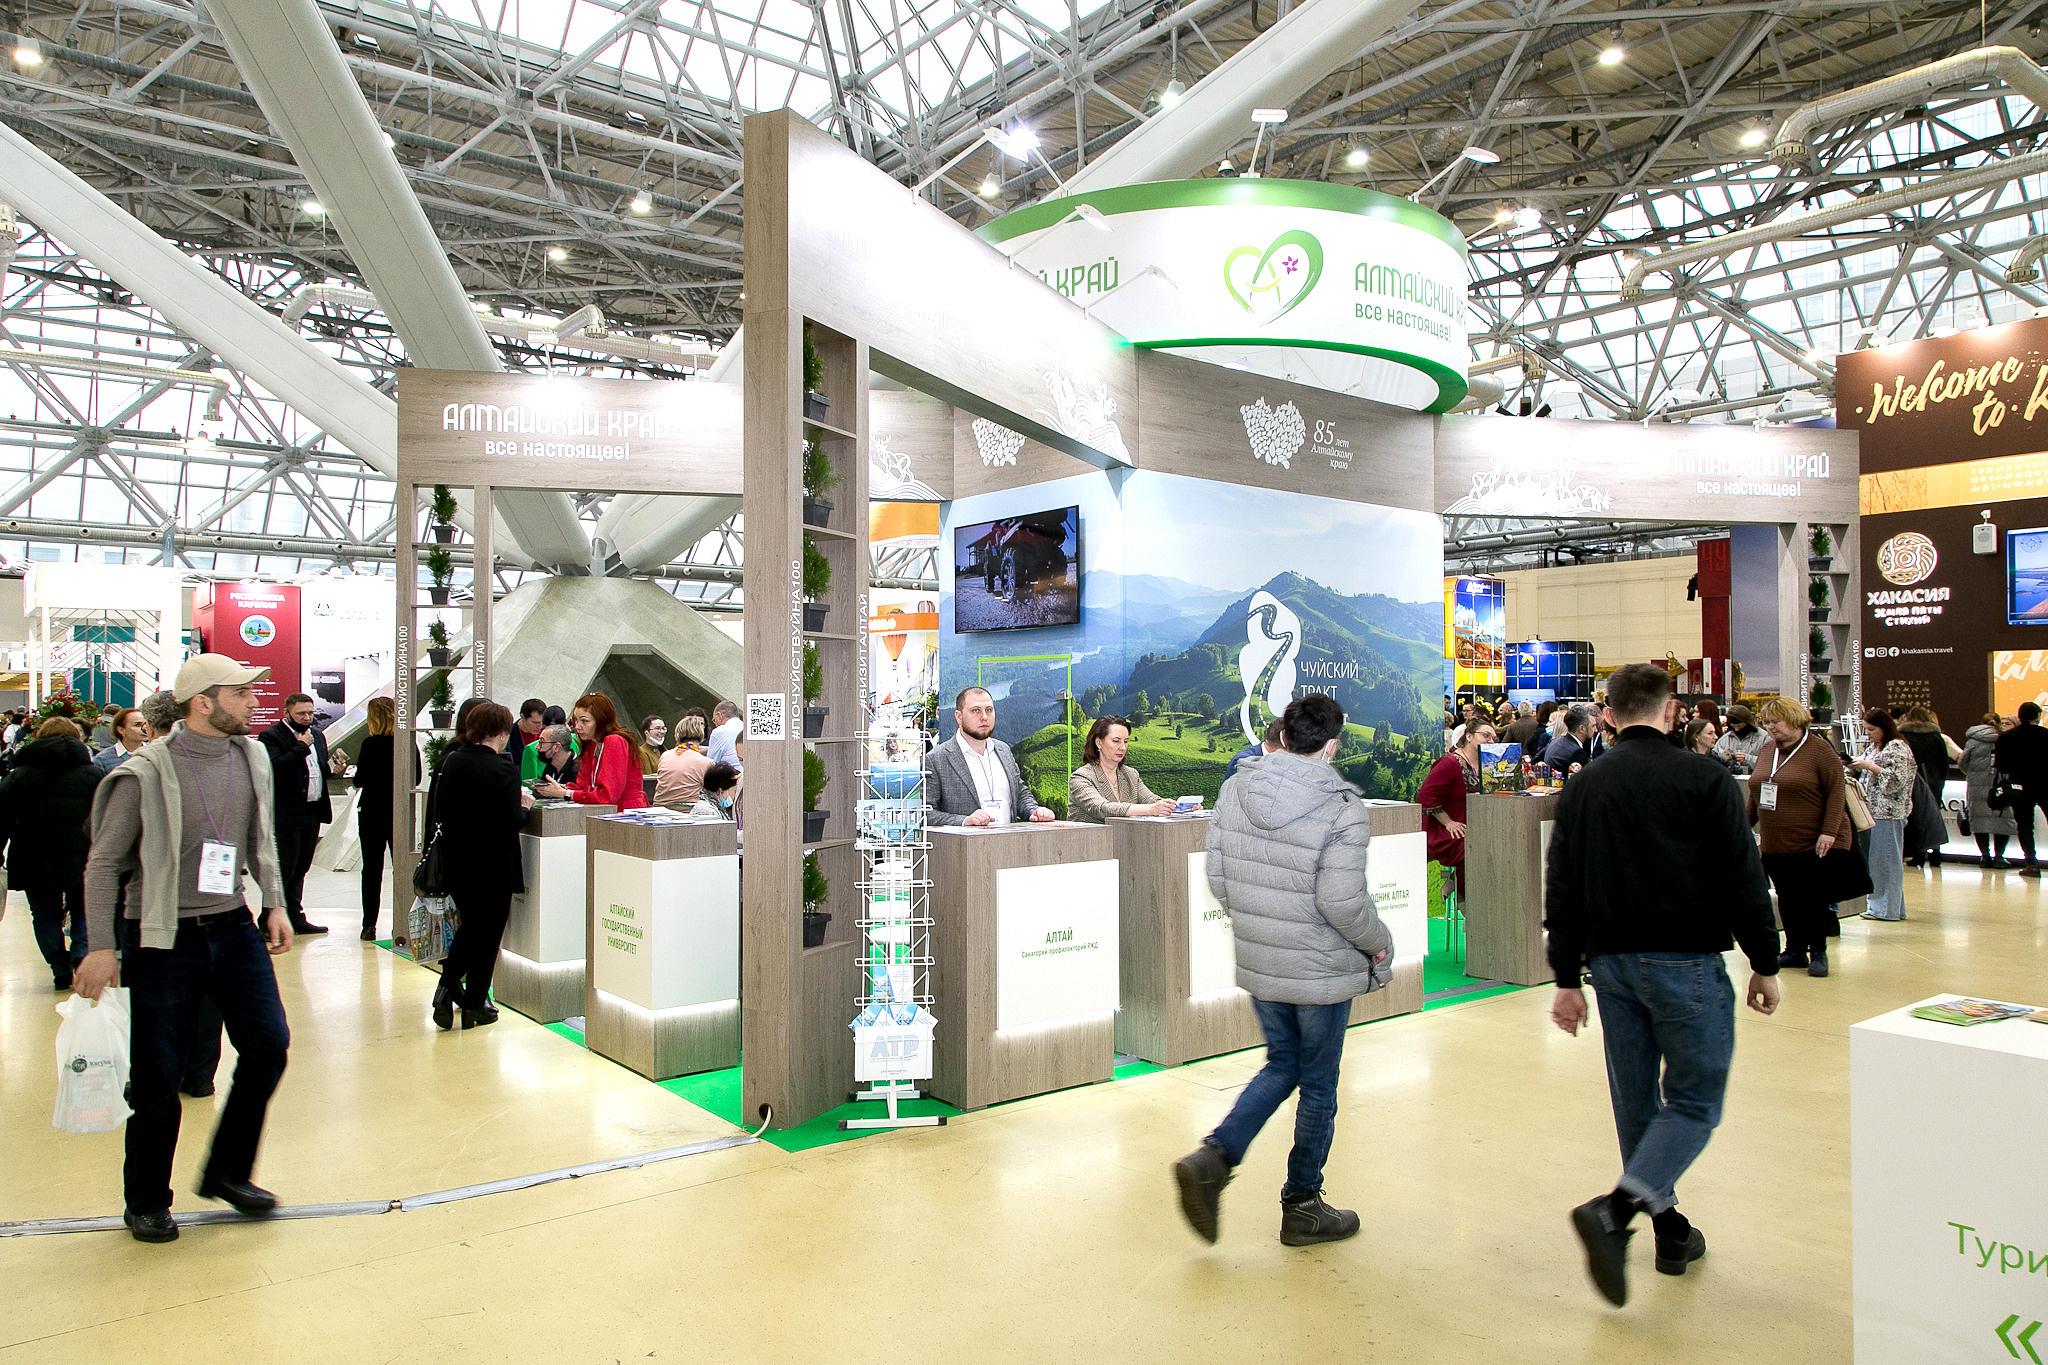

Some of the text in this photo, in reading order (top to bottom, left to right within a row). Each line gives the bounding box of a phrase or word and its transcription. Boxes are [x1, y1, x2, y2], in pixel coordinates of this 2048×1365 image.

[1056, 256, 1119, 298] КРАЙ
[1355, 262, 1454, 319] АЛТАЙСКИЙ
[1355, 303, 1452, 343] все настоящее!
[1866, 359, 2024, 425] Welcome
[1972, 389, 2006, 437] to
[442, 402, 670, 440] АЛТАЙСКИЙ КРАЙ
[1313, 419, 1350, 449] 85 лет
[484, 440, 630, 462] все настоящее!
[1310, 443, 1354, 462] Алтайскому
[1329, 459, 1349, 470] краю
[1783, 452, 1830, 479] КРАЙ
[1696, 480, 1802, 498] все настоящее!
[1866, 587, 1951, 606] ХАКАСИЯ
[1884, 614, 1932, 627] СТИХИЙ
[790, 560, 801, 741] #ПОЧУЙСТВУЙНА100
[858, 593, 868, 708] #ВИЗИТАЛТАЙ
[1901, 646, 1953, 656] khakassia.travel
[397, 625, 409, 730] #ПОЧУЙСТВУЙНА100
[475, 639, 486, 699] ИЗИТАЛТАЙ
[1300, 658, 1360, 679] ЧУЙСКИЙ
[1799, 652, 1808, 710] ВИЗИТАЛТАЙ
[1370, 889, 1410, 903] ОДНИК АЛТАЯ
[609, 903, 635, 920] АЛТАЙСКИЙ
[601, 917, 644, 940] ГОСУДАРСТВЕННЫЙ
[1045, 926, 1073, 944] АЛТАЙ
[607, 935, 637, 955] УНИВЕРСИТЕТ
[1087, 941, 1099, 949] РЖД
[1947, 1221, 2048, 1277] Тури
